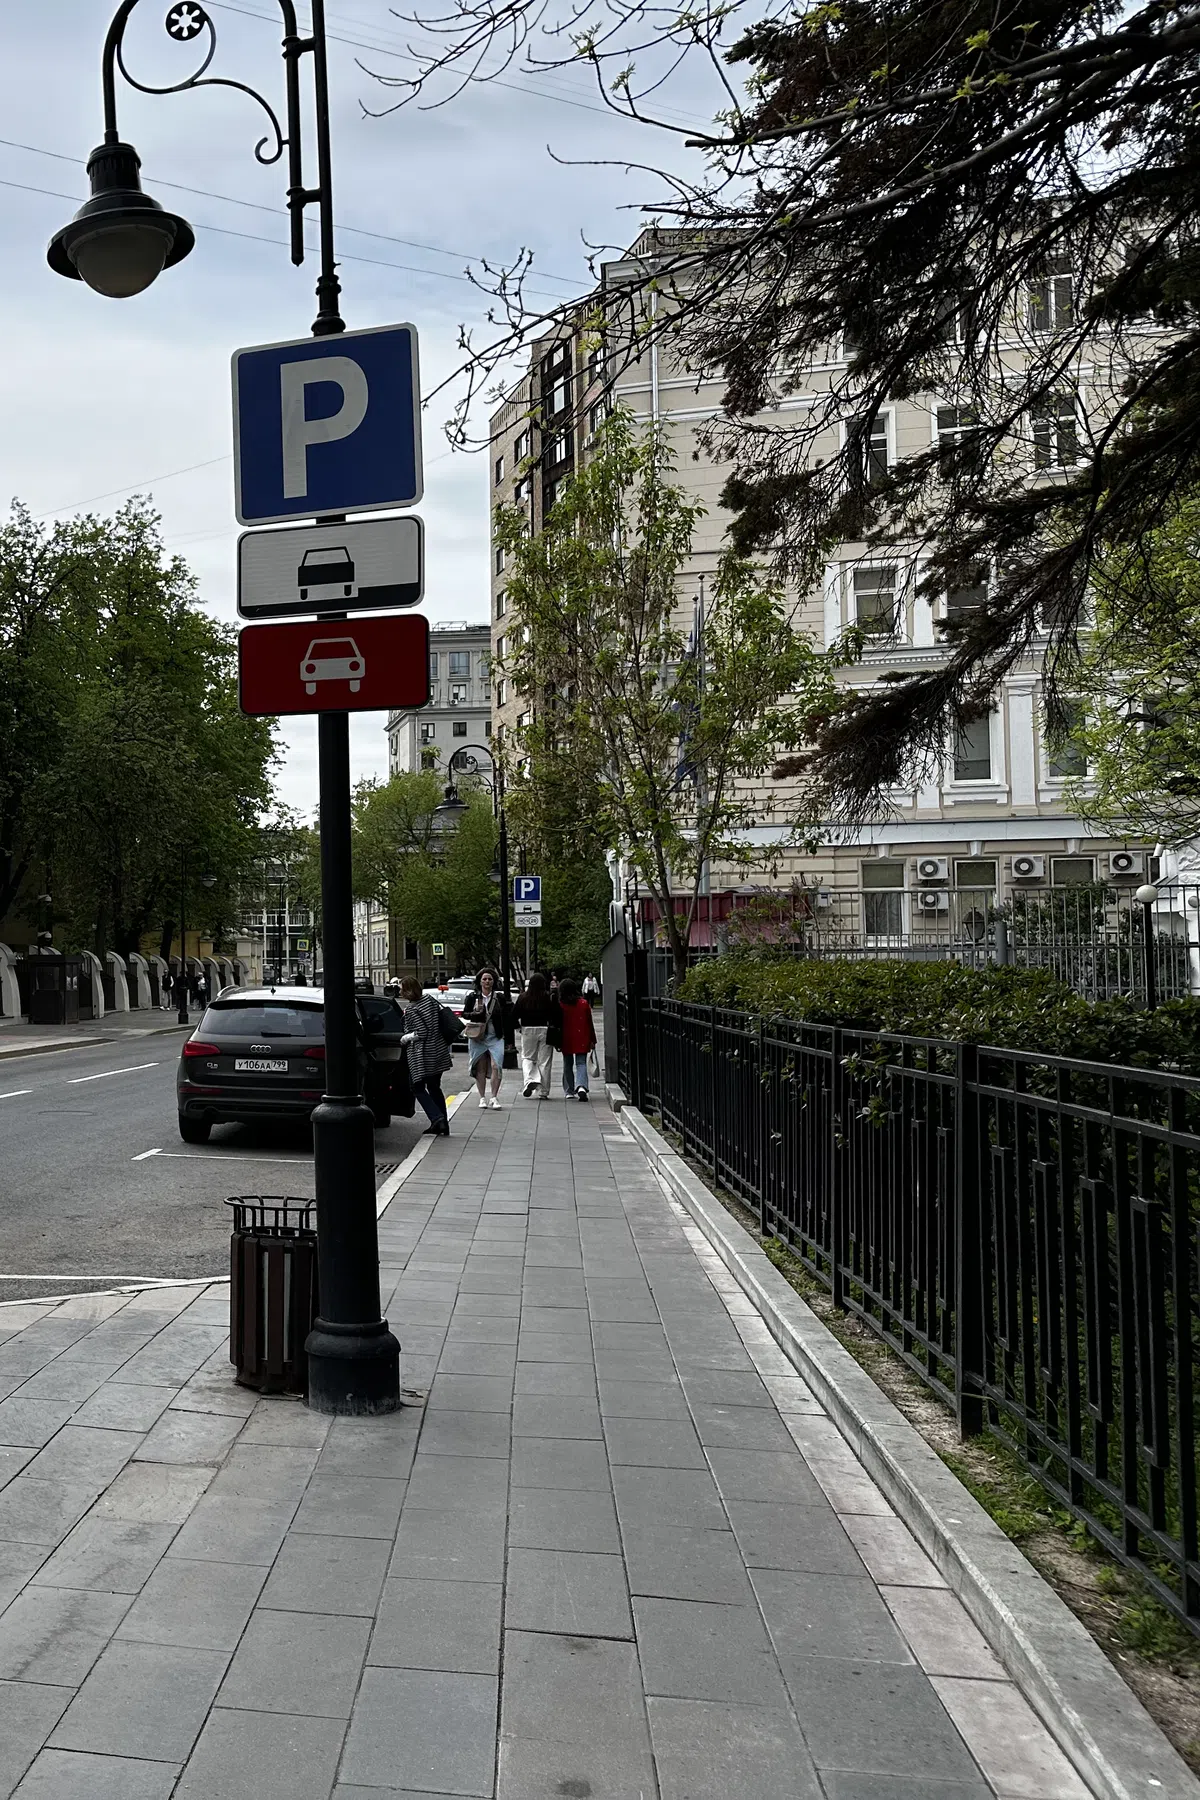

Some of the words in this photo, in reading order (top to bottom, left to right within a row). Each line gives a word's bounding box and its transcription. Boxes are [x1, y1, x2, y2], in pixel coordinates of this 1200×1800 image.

[280, 356, 369, 499] P
[521, 879, 534, 899] P
[238, 1060, 271, 1070] У106АА
[272, 1060, 286, 1068] 799
